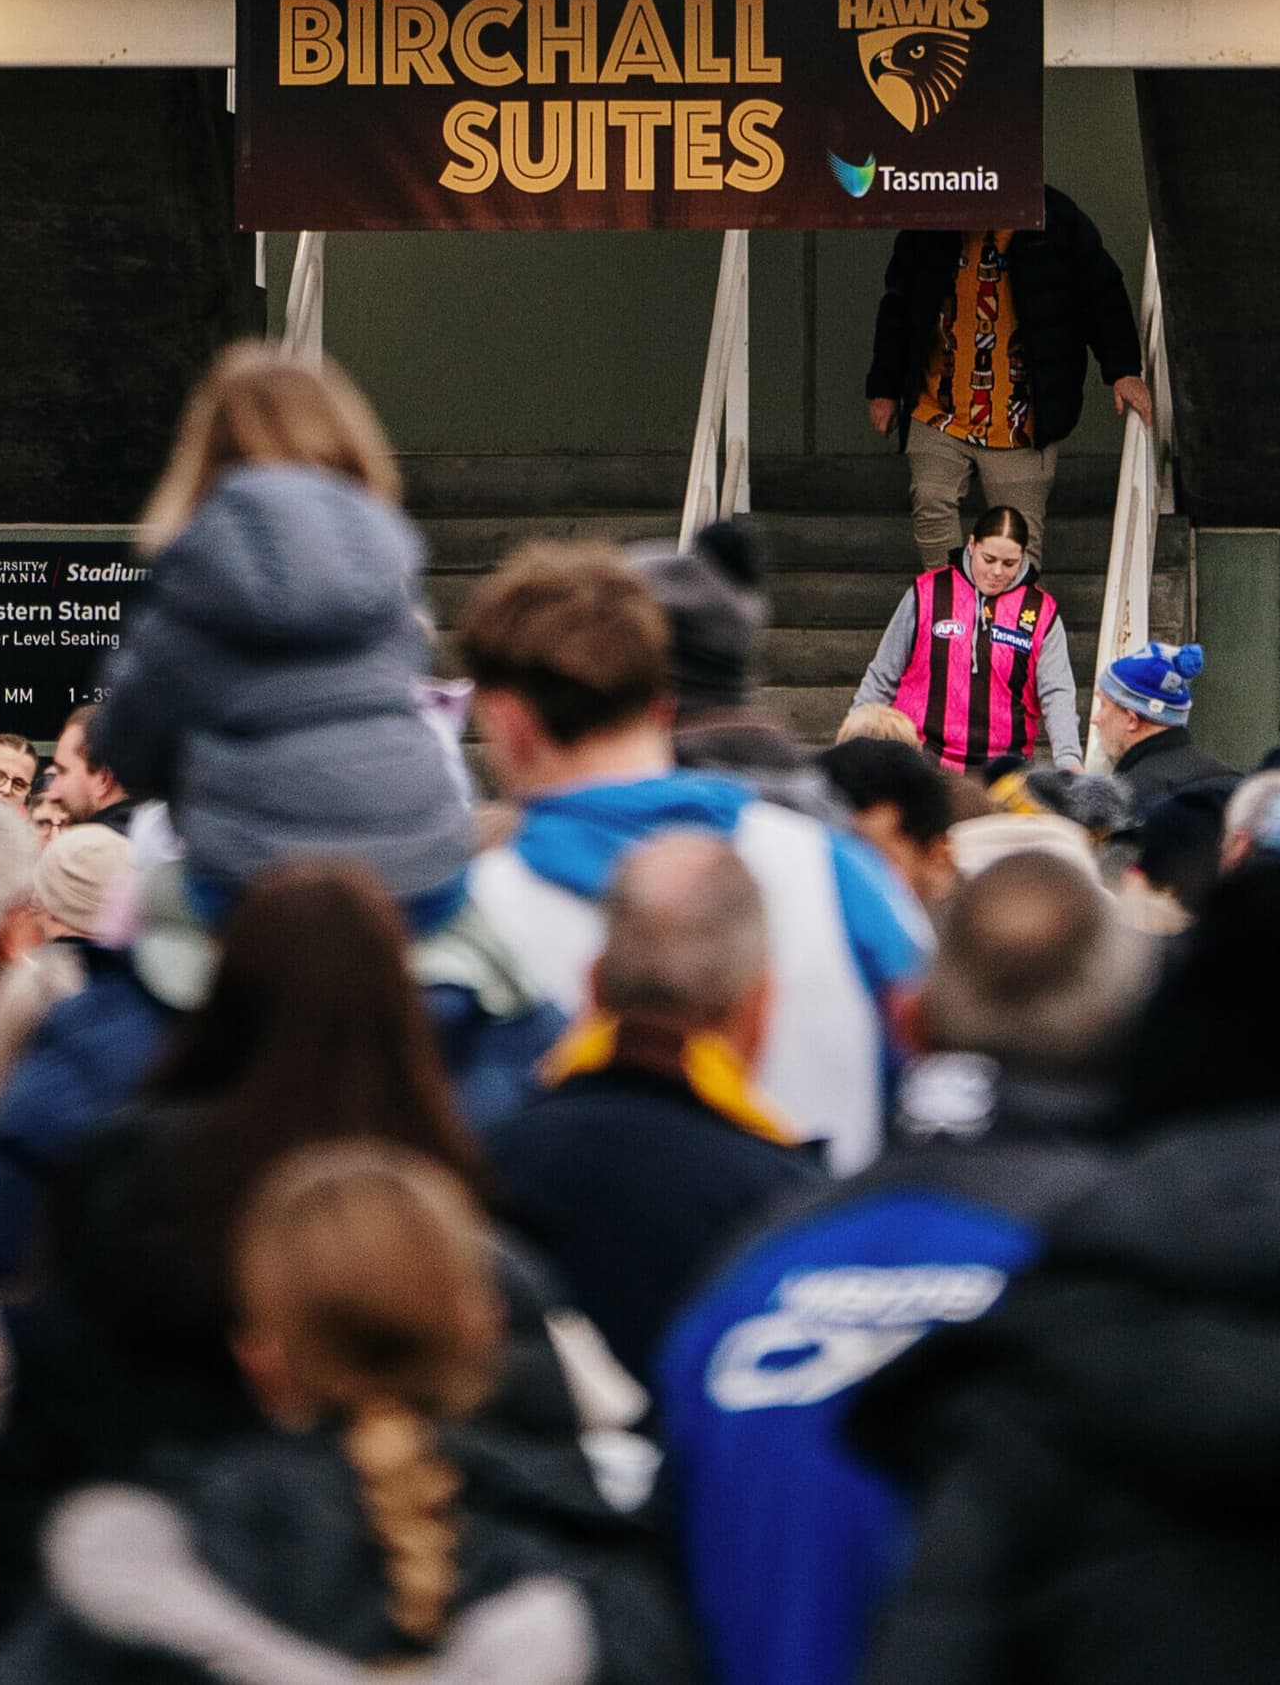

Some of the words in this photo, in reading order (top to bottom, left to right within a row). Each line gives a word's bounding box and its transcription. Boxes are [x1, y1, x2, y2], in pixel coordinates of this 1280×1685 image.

[438, 99, 785, 194] SUITES
[877, 165, 1000, 192] Tasmania
[66, 562, 153, 582] Stadium
[58, 600, 121, 621] Stand
[935, 623, 963, 636] AFL
[14, 630, 56, 647] Level
[60, 630, 121, 650] Seating
[4, 688, 33, 704] MM
[68, 687, 75, 703] 1
